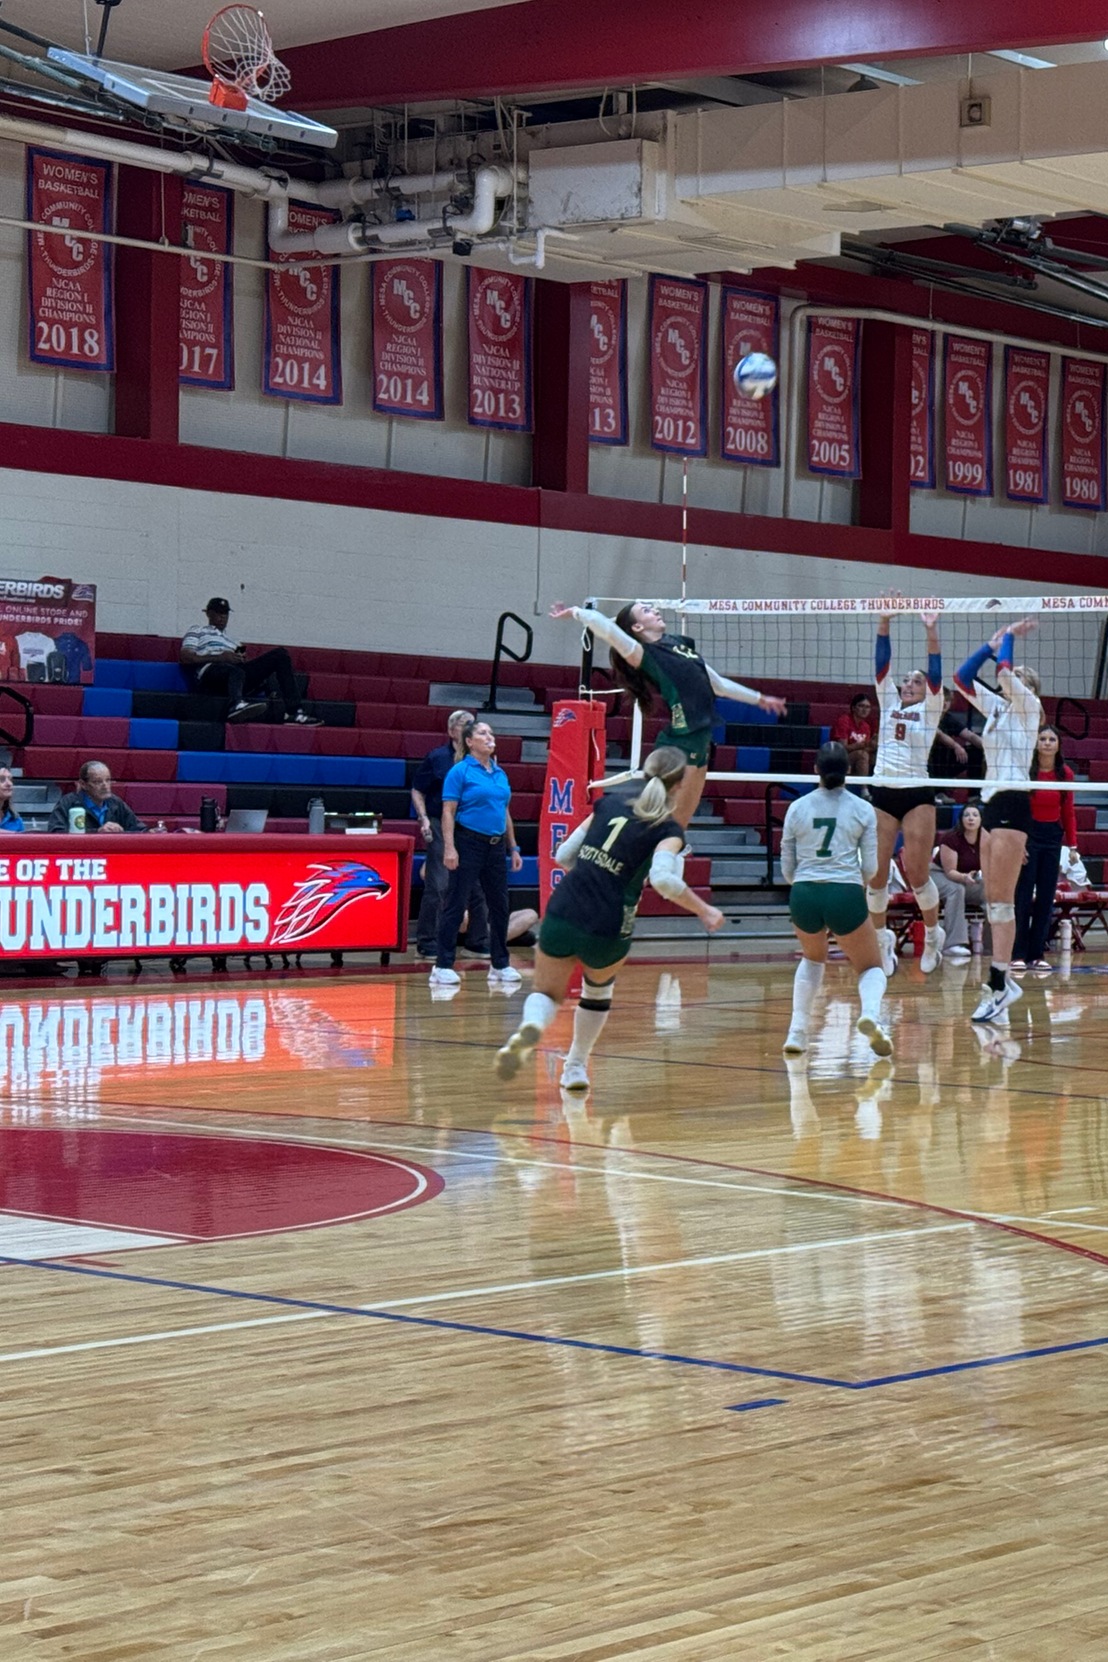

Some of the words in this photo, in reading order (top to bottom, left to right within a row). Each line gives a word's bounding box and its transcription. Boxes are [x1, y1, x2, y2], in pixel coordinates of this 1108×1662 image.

[43, 164, 97, 184] WOMEN'S
[38, 179, 99, 198] BASKETBALL
[183, 192, 220, 208] MEN'S
[181, 209, 221, 222] KETBALL
[52, 278, 81, 291] NJCAA
[47, 288, 82, 301] REGION
[393, 279, 420, 319] MCC
[660, 285, 699, 302] WOMEN'S
[42, 298, 82, 312] DIVISION
[85, 304, 92, 314] II
[486, 290, 510, 328] MCC
[658, 298, 700, 313] BASKETBALL
[733, 300, 770, 314] WOMEN'S
[39, 308, 96, 324] CHAMPIONS
[287, 317, 313, 328] NJCAA
[730, 312, 770, 325] BASKETBALL
[37, 321, 100, 357] 2018
[277, 326, 314, 338] DIVISION
[392, 334, 417, 346] NJCAA
[815, 328, 853, 342] BASKETBALL
[279, 335, 320, 350] NATIONAL
[386, 343, 416, 355] REGION
[483, 343, 509, 357] NJCAA
[668, 327, 690, 365] MCC
[952, 343, 985, 355] WOMEN'S
[179, 343, 218, 374] 017
[275, 344, 324, 360] CHAMPIONS
[382, 352, 417, 365] DIVISION
[472, 353, 511, 368] DIVISION
[273, 358, 327, 389] 2014
[379, 362, 426, 376] CHAMPIONS
[475, 365, 518, 380] NATIONAL
[823, 357, 844, 392] MCC
[1012, 366, 1046, 378] BASKETBALL
[1069, 365, 1100, 377] WOMEN'S
[377, 375, 429, 406] 2014
[473, 376, 520, 392] RUNNER-UP
[660, 386, 686, 398] REGION
[473, 389, 520, 418] 2013
[958, 381, 977, 413] MCC
[655, 404, 694, 416] CHAMPIONS
[1020, 391, 1038, 423] MCC
[593, 408, 616, 432] 13
[1075, 401, 1092, 433] MCC
[654, 416, 696, 444] 2012
[726, 426, 768, 454] 2008
[811, 440, 850, 466] 2005
[949, 461, 982, 484] 1999
[1065, 464, 1098, 475] CHAMPIONS
[1009, 470, 1039, 493] 1981
[1065, 477, 1098, 500] 1980
[6, 605, 38, 615] ONLINE
[41, 608, 67, 616] STORE
[70, 610, 88, 618] AND
[708, 600, 739, 612] MESA
[741, 600, 807, 611] COMMUNITY
[810, 599, 857, 611] COLLEGE
[859, 598, 946, 611] THUNDERBIRDS
[1041, 597, 1076, 610] MESA
[602, 816, 629, 852] 1
[813, 818, 837, 857] 7
[16, 859, 50, 881] OF
[55, 858, 107, 881] THE
[0, 882, 270, 951] UNDERBIRDS
